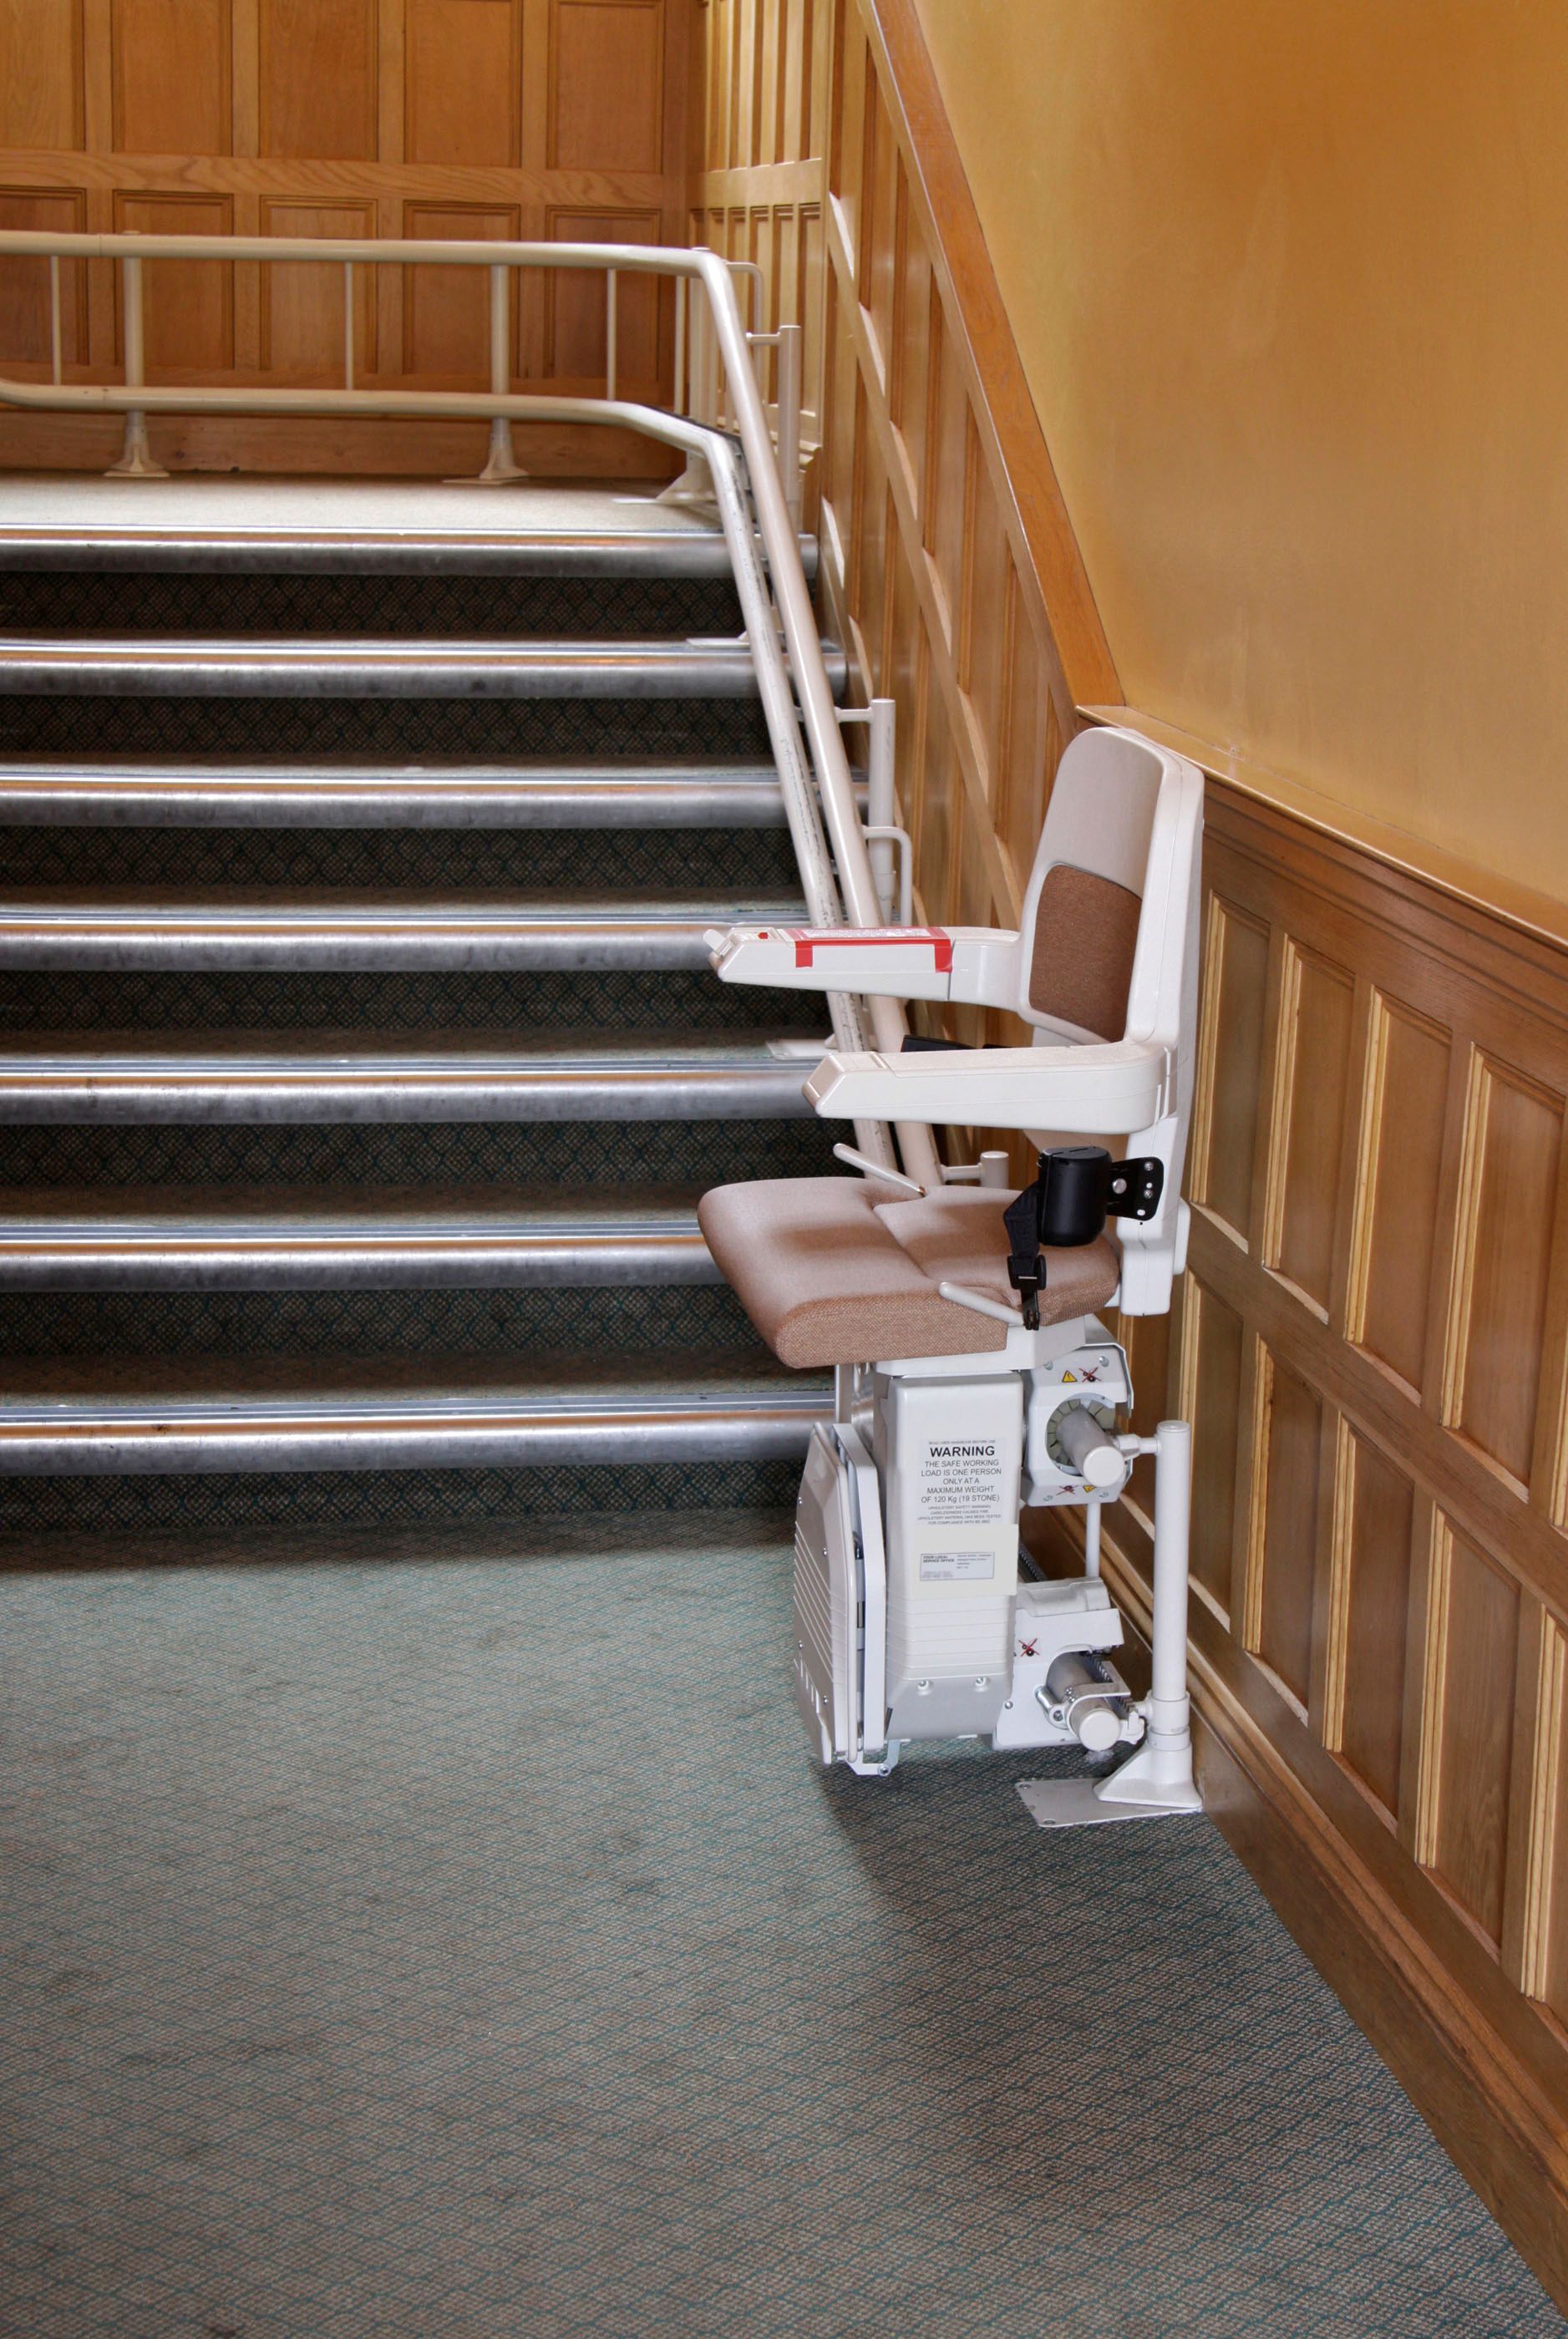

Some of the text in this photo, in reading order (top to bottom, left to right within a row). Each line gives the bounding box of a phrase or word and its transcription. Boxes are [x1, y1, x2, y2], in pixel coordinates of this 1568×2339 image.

[930, 1446, 995, 1457] WARNING
[959, 1495, 969, 1504] (19
[972, 1494, 1000, 1503] STONE)
